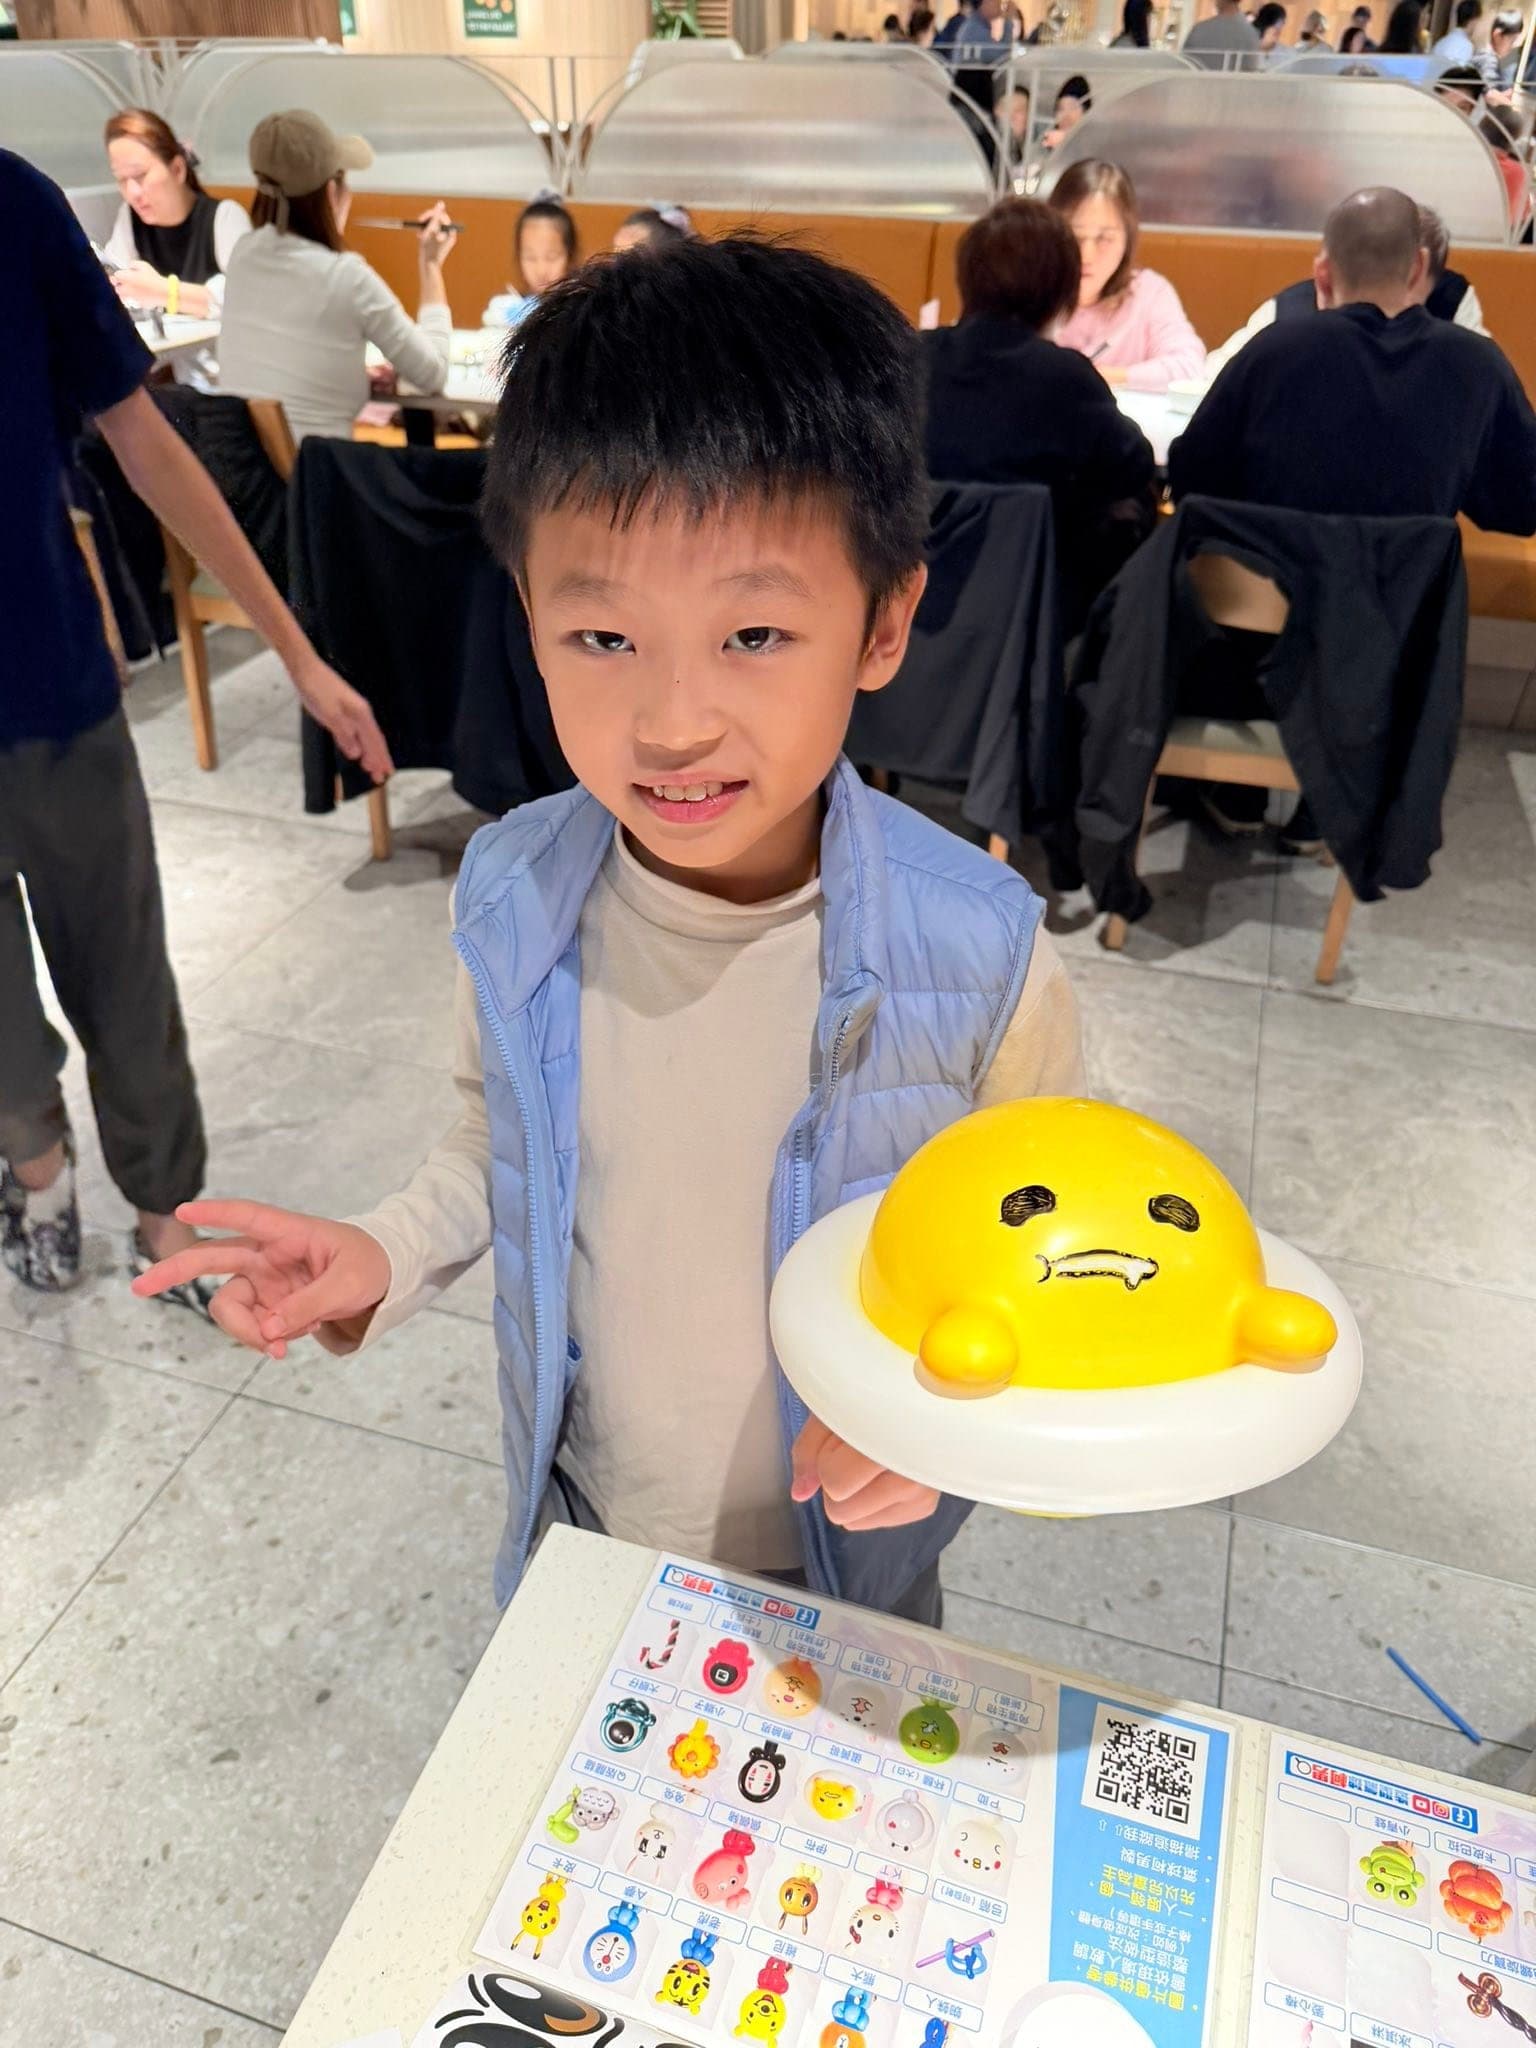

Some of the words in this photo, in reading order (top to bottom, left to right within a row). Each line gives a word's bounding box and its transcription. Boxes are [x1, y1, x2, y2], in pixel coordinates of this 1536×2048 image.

[786, 1639, 827, 1660] 角落生物
[851, 1661, 892, 1682] 角落生物
[628, 1677, 660, 1694] 大眼仔
[918, 1682, 960, 1703] 角落生物
[694, 1700, 725, 1717] 小獅子
[986, 1704, 1029, 1725] 角落生物
[761, 1722, 792, 1740] 無臉男
[829, 1744, 862, 1764] 蛋黃哥
[584, 1760, 627, 1781] Q版龍貓
[728, 1811, 761, 1832] 佩佩豬
[1374, 1815, 1410, 1836] 小青蛙
[804, 1838, 827, 1856] 伊布
[1447, 1839, 1496, 1864] 卡皮巴拉
[552, 1856, 577, 1874] 皮卡
[1120, 1847, 1198, 1882] 氣球柯男製
[624, 1885, 647, 1900] A夢
[1102, 1864, 1195, 1905] 先以兒童為主
[698, 1911, 722, 1930] 老虎
[773, 1939, 797, 1958] 維尼
[1107, 1935, 1188, 1972] 整造型做法
[1073, 1941, 1185, 1991] 會依現場人數調
[850, 1967, 877, 1987] 熊大
[926, 1994, 962, 2020] 蜘蛛人
[1284, 1995, 1324, 2018] 愛心棒
